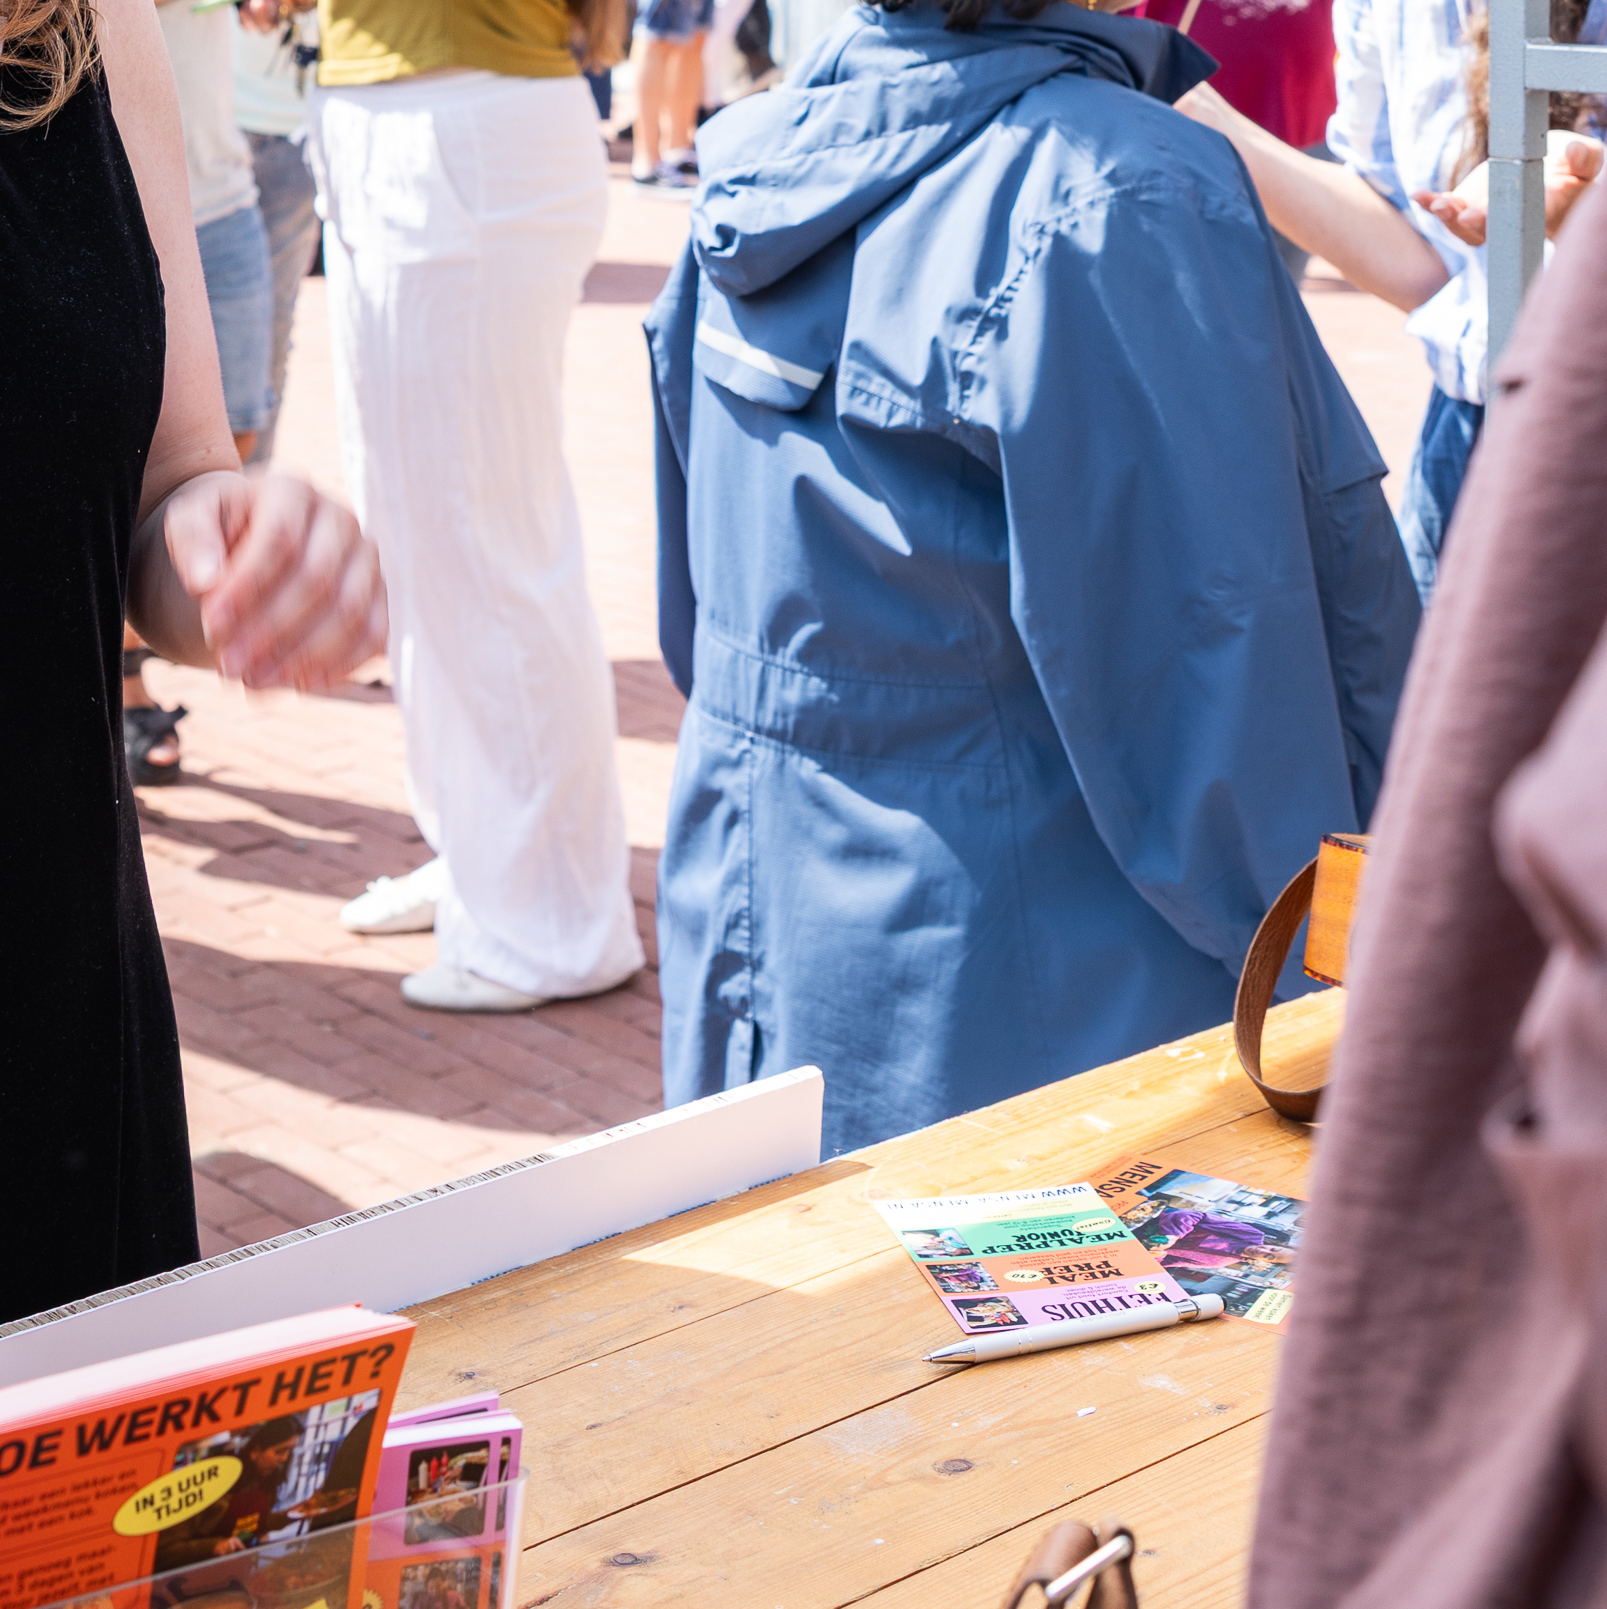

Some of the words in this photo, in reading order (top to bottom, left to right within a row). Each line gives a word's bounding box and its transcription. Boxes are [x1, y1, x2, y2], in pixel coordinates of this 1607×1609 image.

[1094, 1161, 1163, 1198] MENSA
[982, 1230, 1128, 1254] MEALPREP
[1044, 1268, 1125, 1285] MEAL
[75, 1377, 262, 1458] WERKT
[268, 1343, 395, 1408] HET?
[135, 1493, 155, 1514] IN
[160, 1486, 172, 1502] 3
[177, 1465, 219, 1494] UUR
[154, 1488, 204, 1521] TIJD!
